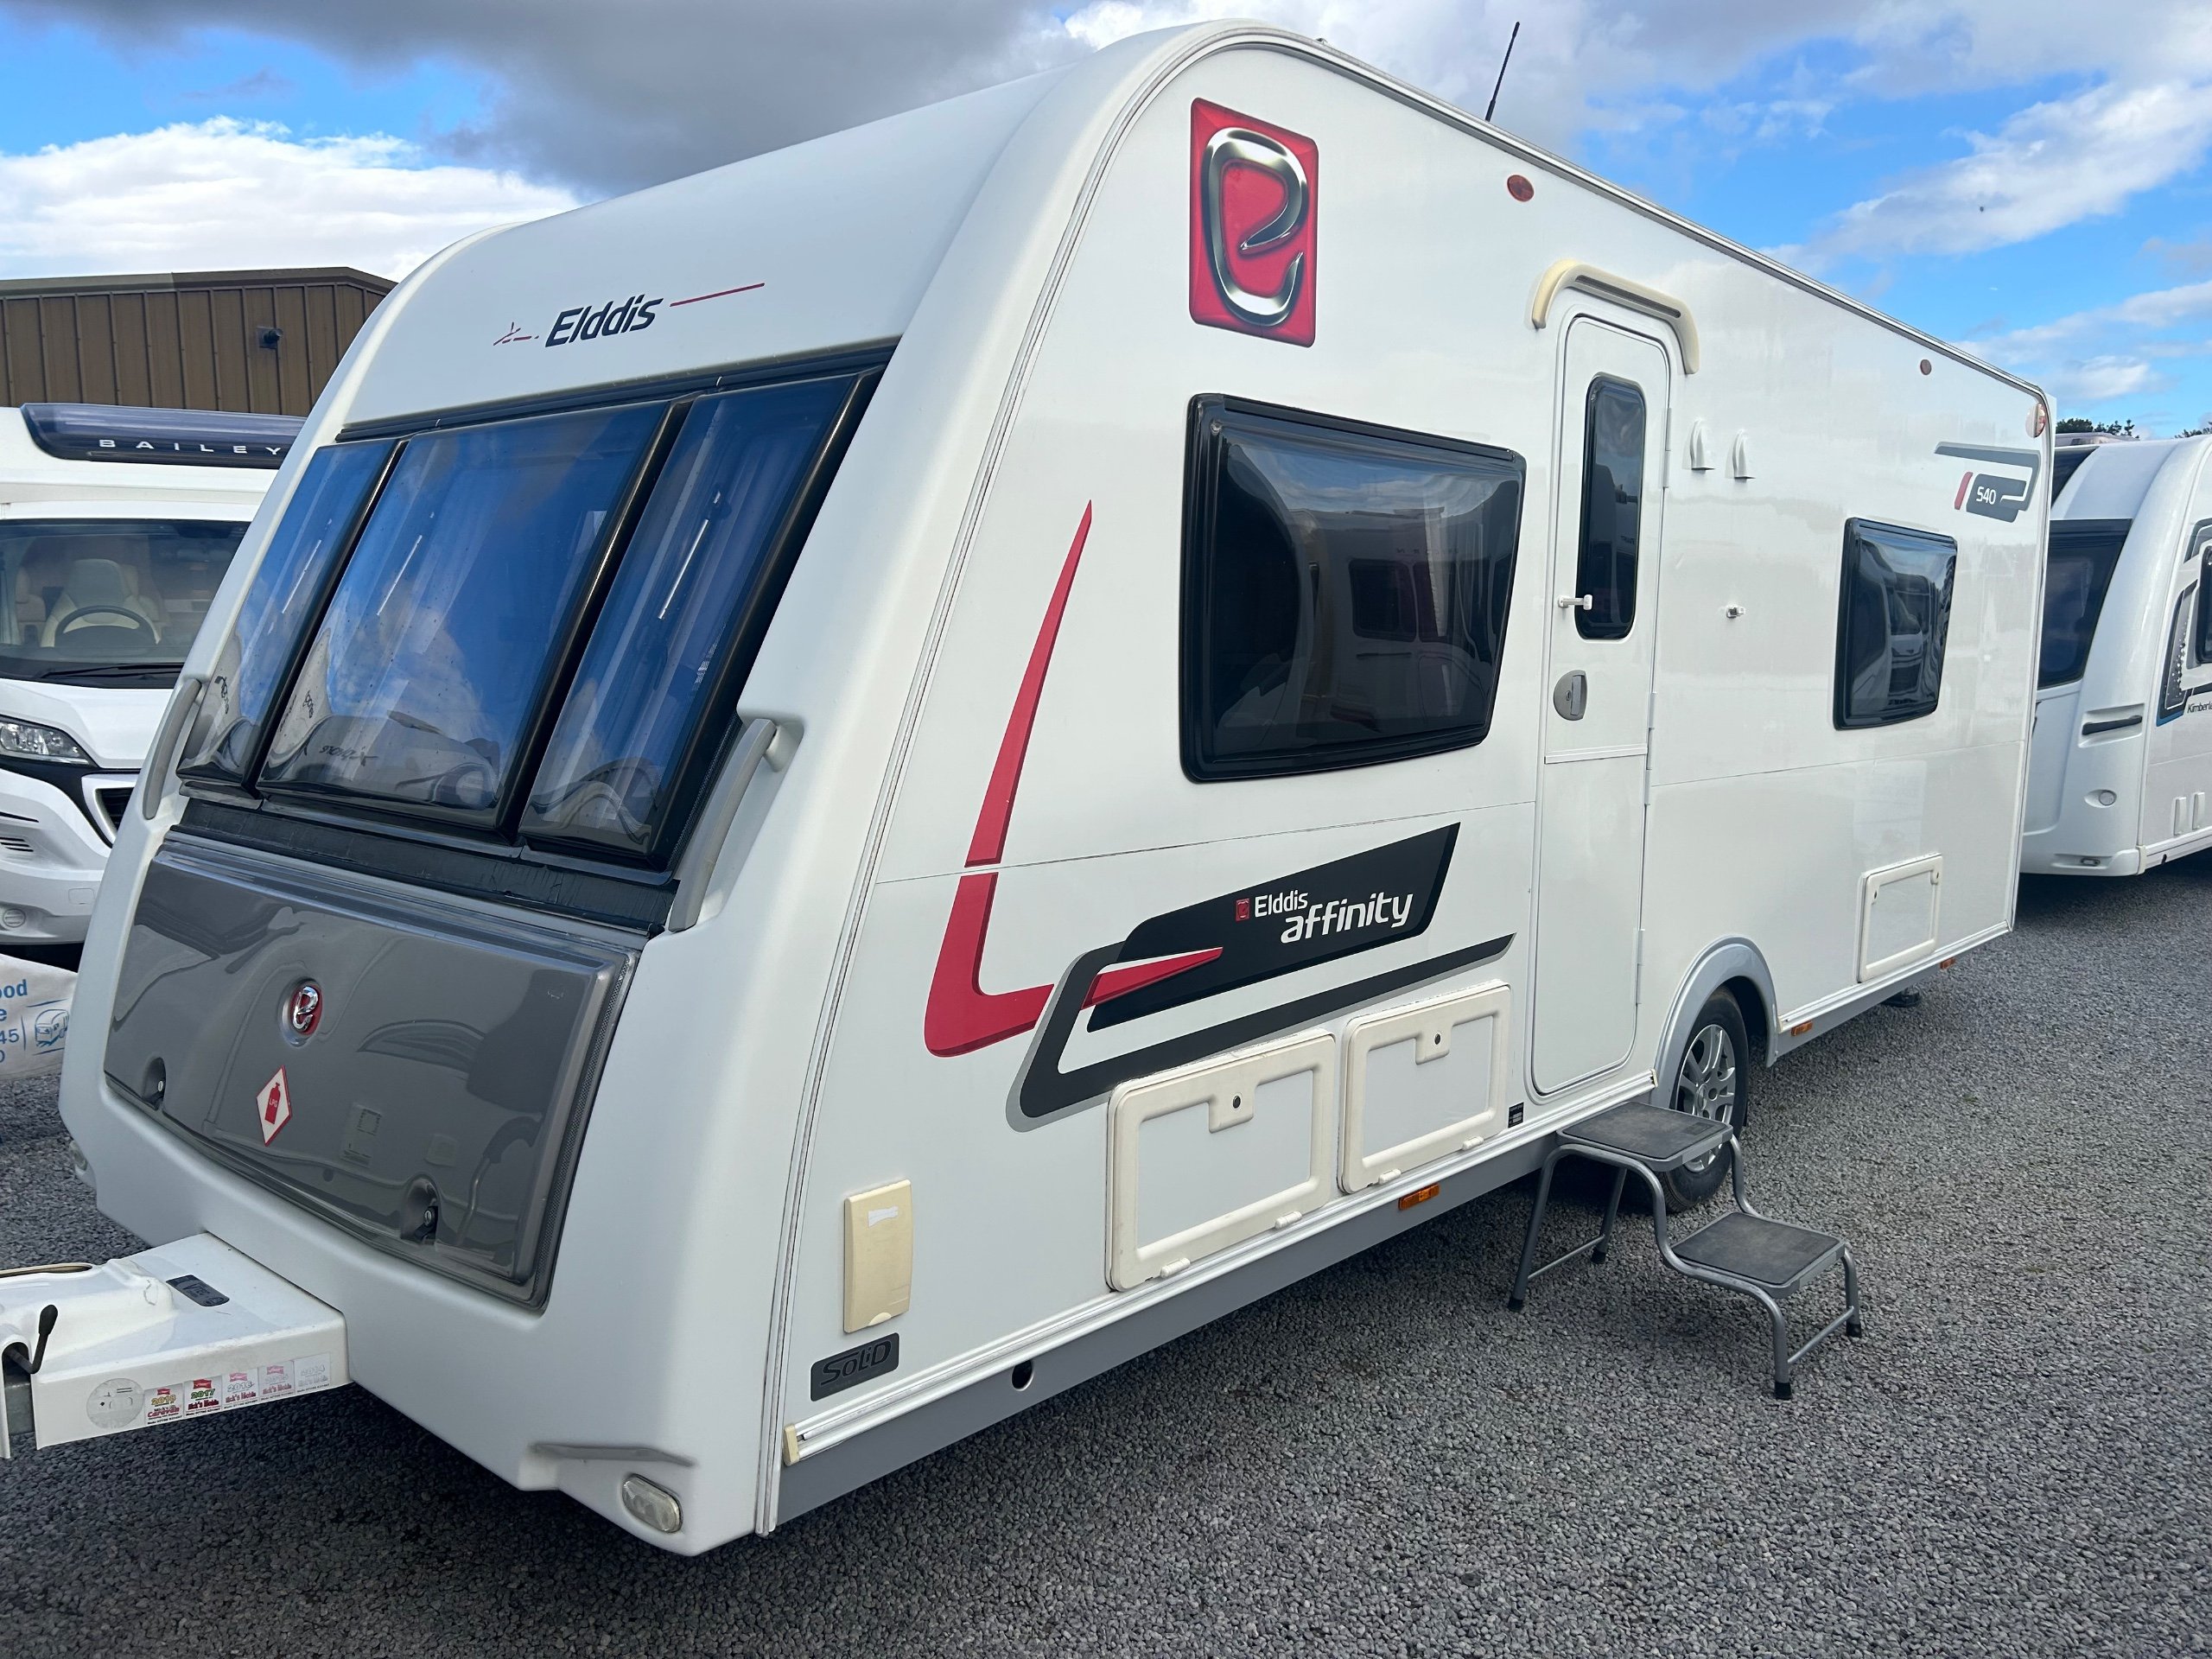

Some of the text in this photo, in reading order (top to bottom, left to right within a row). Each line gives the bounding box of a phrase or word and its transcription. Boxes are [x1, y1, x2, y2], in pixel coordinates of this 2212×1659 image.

[544, 294, 664, 347] Elddis
[99, 439, 281, 455] BAILEY
[1976, 486, 1996, 505] 540
[1255, 890, 1309, 918] Elddis
[1281, 892, 1414, 944] affinity
[190, 1389, 216, 1400] 2017
[227, 1381, 251, 1392] 2016
